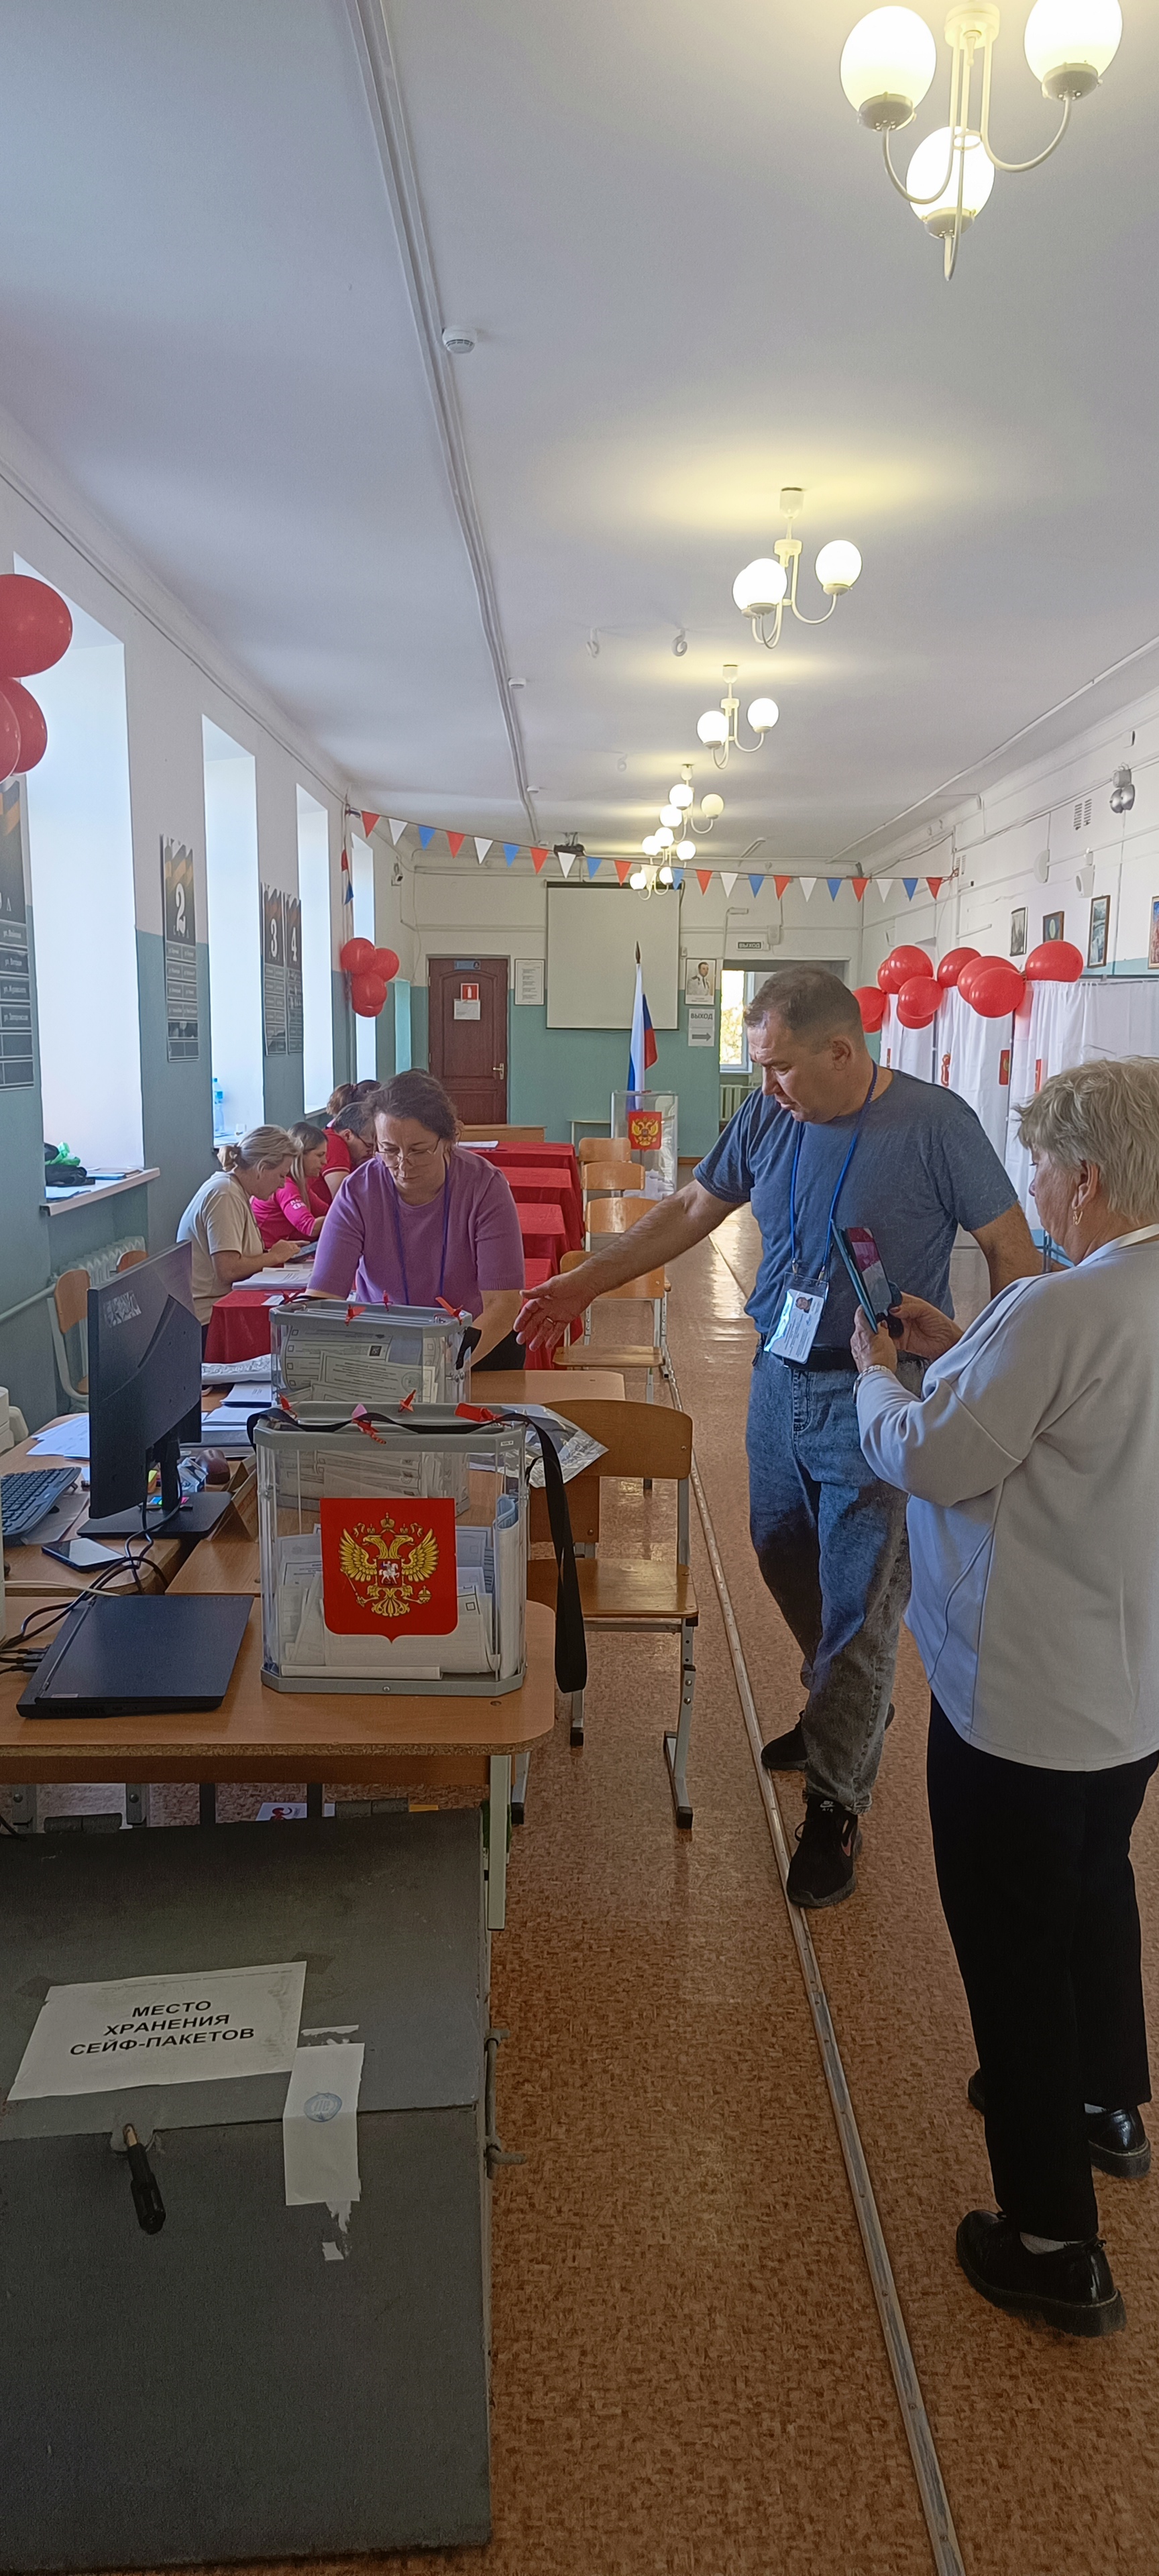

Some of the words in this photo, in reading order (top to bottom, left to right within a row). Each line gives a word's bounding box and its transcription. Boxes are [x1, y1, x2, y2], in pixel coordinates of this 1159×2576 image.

[176, 883, 186, 934] 2
[270, 918, 278, 958] 3
[291, 926, 297, 962] 4
[131, 2000, 212, 2017] МЕСТО
[103, 2014, 230, 2036] ХРАНЕНИЯ
[70, 2028, 255, 2055] СЕЙФ-ПАКЕТОВ
